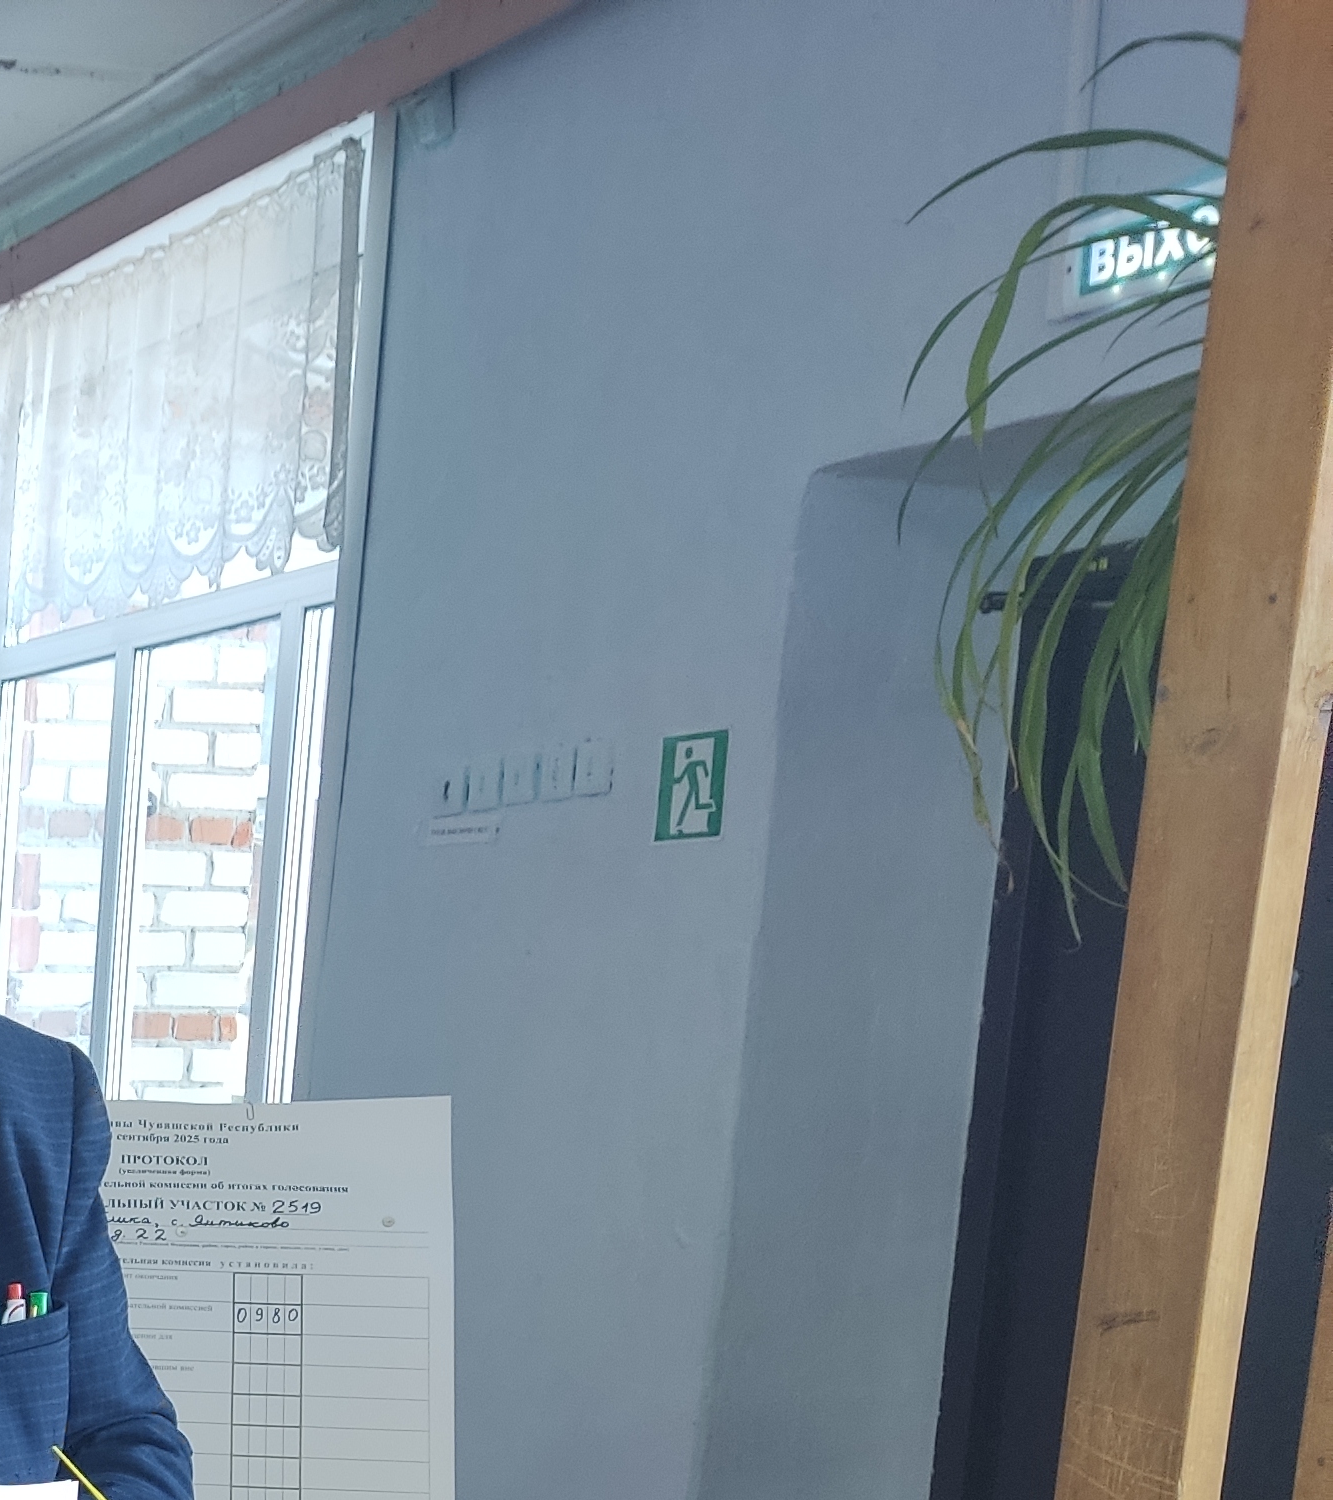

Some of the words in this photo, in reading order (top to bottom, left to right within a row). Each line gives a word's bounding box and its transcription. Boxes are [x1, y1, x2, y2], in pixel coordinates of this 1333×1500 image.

[138, 1119, 213, 1131] Чувашской
[219, 1122, 299, 1134] Республики
[116, 1133, 170, 1144] сентября
[173, 1134, 200, 1143] 2025
[203, 1136, 229, 1144] года
[121, 1154, 208, 1166] ПРОТОКОЛ
[103, 1180, 146, 1188] ельной
[149, 1181, 207, 1189] комиссии
[210, 1181, 225, 1190] об
[227, 1183, 268, 1191] итогах
[271, 1184, 349, 1193] голосования
[104, 1197, 164, 1209] ЛЬНЫЙ
[169, 1199, 247, 1212] УЧАСТОК
[250, 1201, 266, 1212] №
[272, 1199, 322, 1214] 2519
[161, 1259, 211, 1267] комиссия
